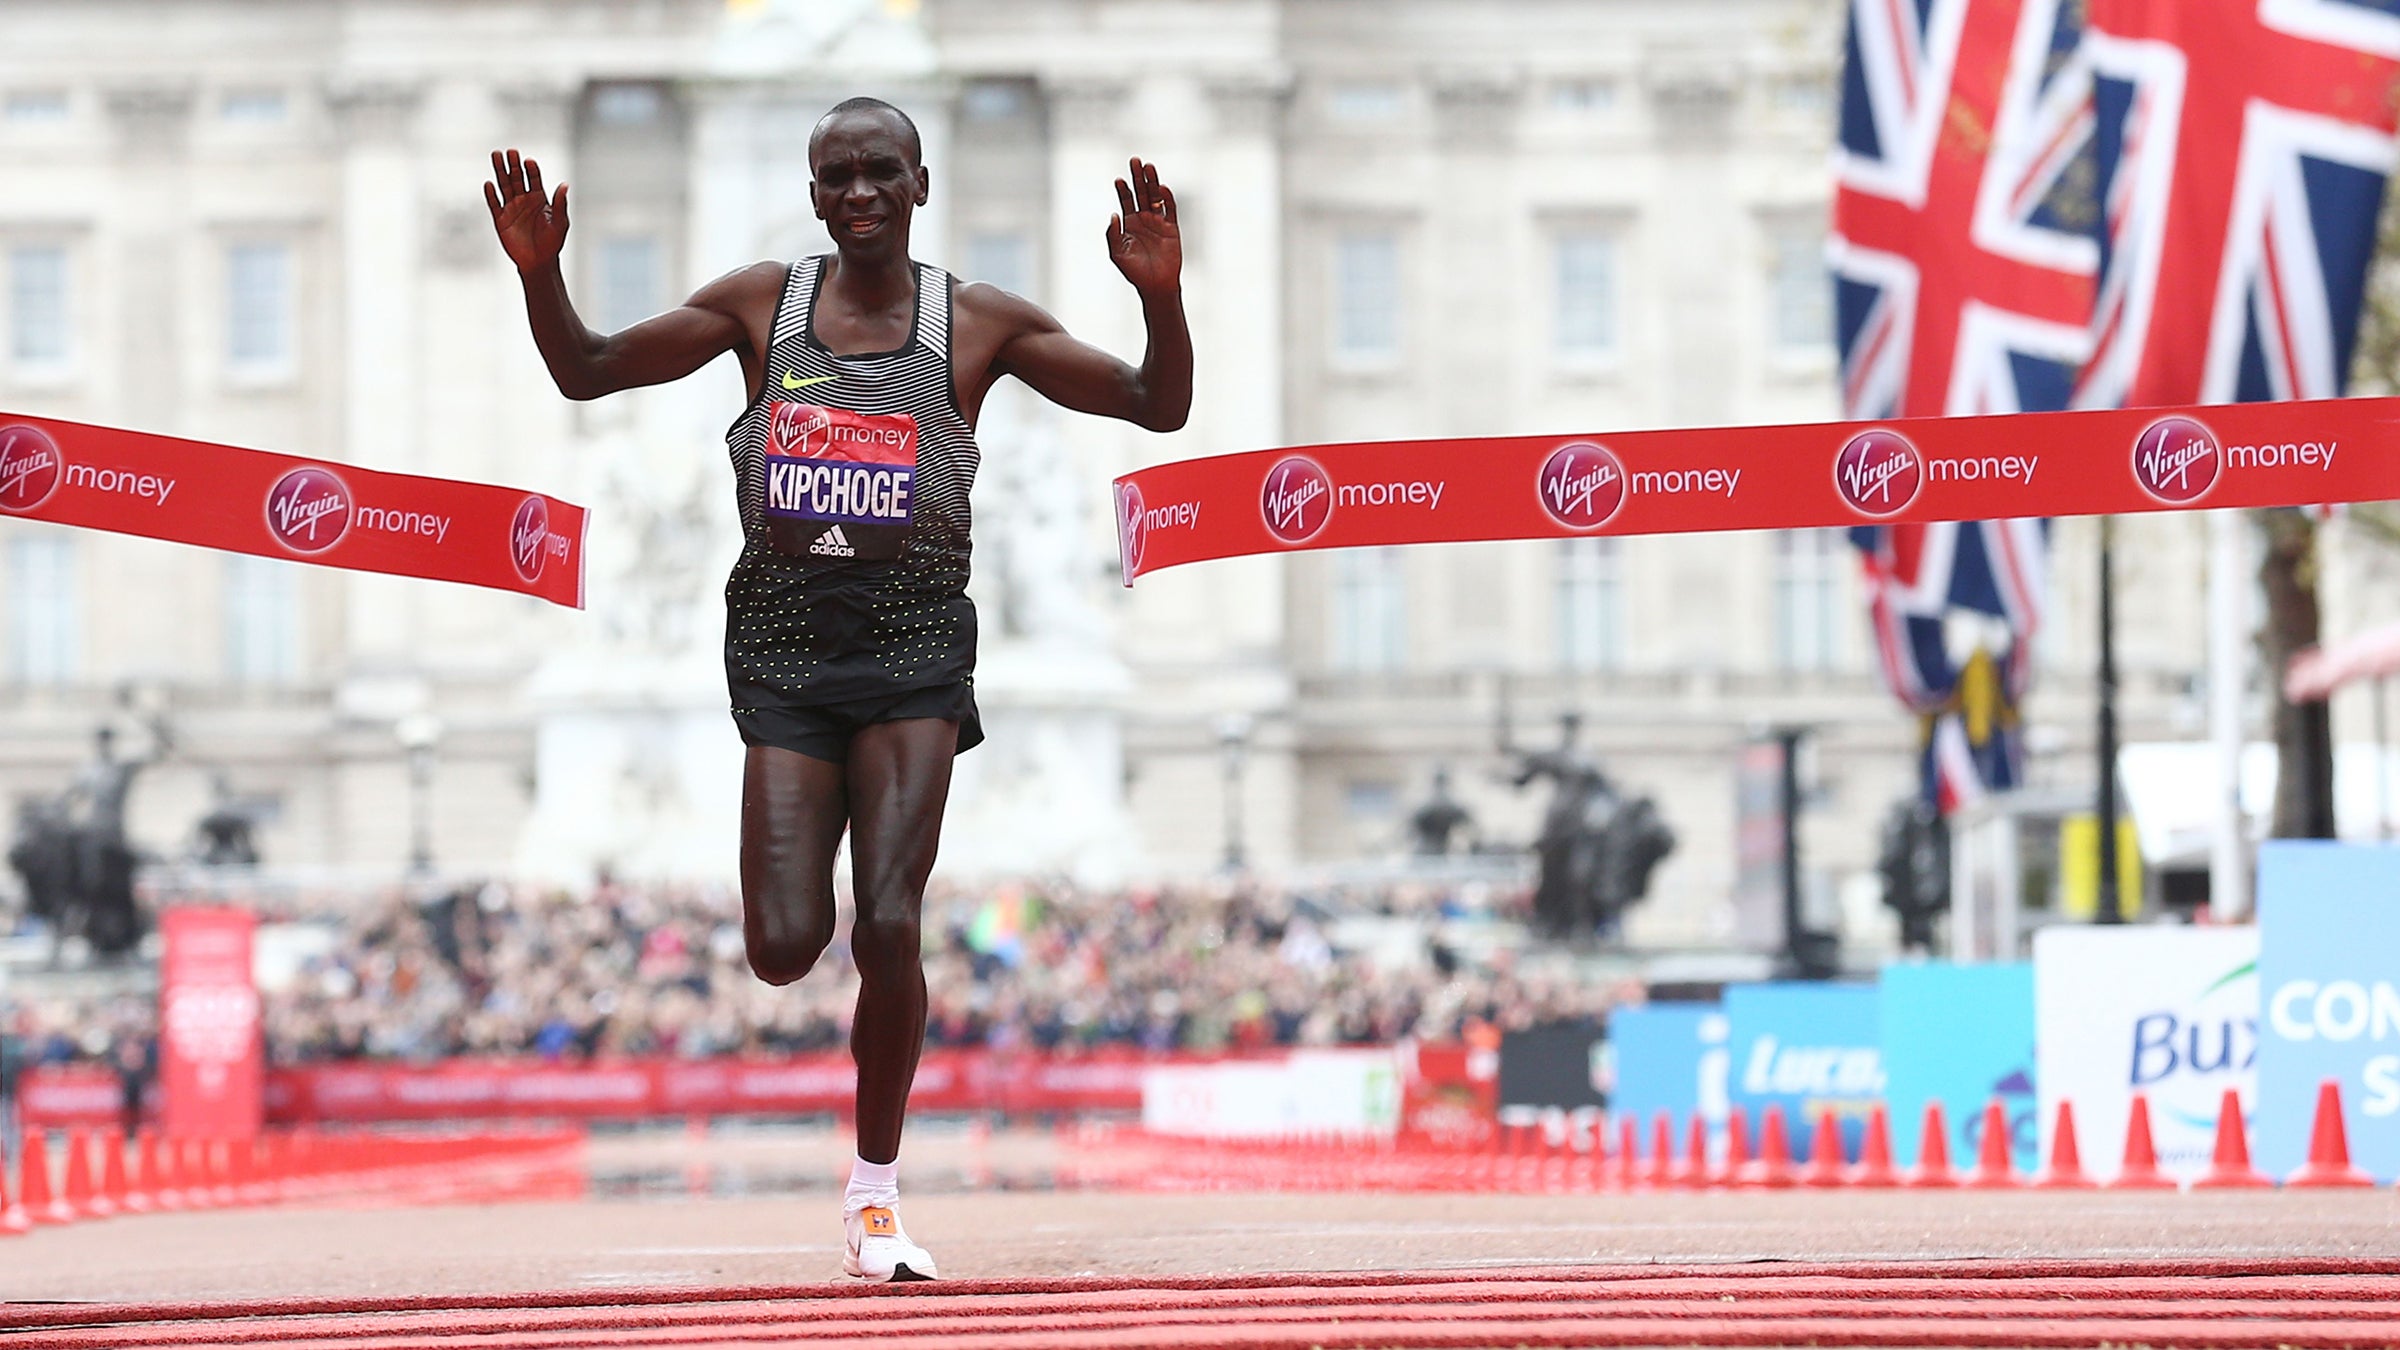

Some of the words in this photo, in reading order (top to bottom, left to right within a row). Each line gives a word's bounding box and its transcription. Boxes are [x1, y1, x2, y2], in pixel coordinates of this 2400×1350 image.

[776, 404, 826, 453] Virgin
[834, 424, 911, 450] money
[65, 463, 176, 506] money
[1547, 455, 1617, 516] Virgin
[1631, 468, 1741, 498] money
[1844, 442, 1914, 503] Virgin
[1928, 456, 2039, 485] money
[2141, 429, 2212, 490] Virgin
[2226, 442, 2338, 471] money
[275, 477, 345, 540] Virgin
[356, 504, 451, 543] money
[769, 462, 910, 518] KIPCHOGE
[1146, 501, 1201, 530] money
[1268, 469, 1325, 530] Virgin
[1338, 480, 1445, 510] money
[515, 506, 546, 569] Virgin
[809, 543, 855, 557] adidas
[1743, 1036, 1888, 1094] Luco
